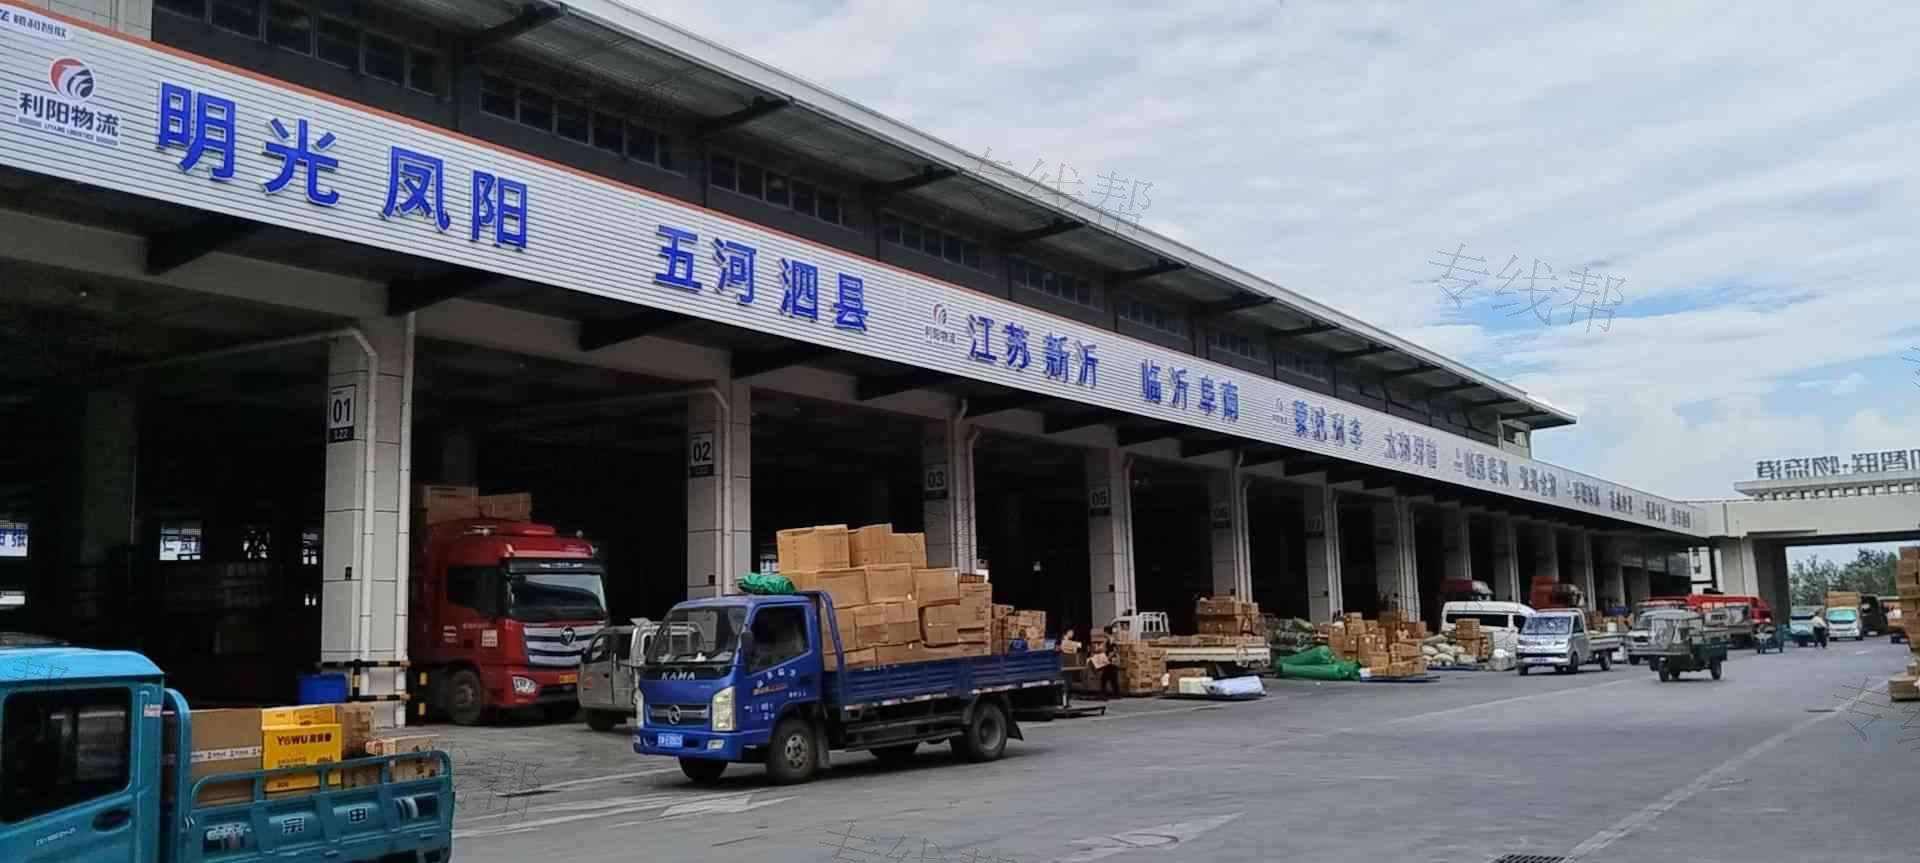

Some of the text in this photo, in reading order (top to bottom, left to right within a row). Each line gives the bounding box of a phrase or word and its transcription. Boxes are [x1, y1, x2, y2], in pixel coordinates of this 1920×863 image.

[19, 92, 119, 137] 利阳物流
[157, 82, 529, 250] 明光 凤阳
[654, 224, 869, 333] 五河 泗县
[968, 313, 1099, 389] 江苏 新沂
[333, 398, 351, 423] 01
[693, 441, 711, 462] 02
[927, 471, 945, 488] 03
[661, 671, 696, 680] KAMA
